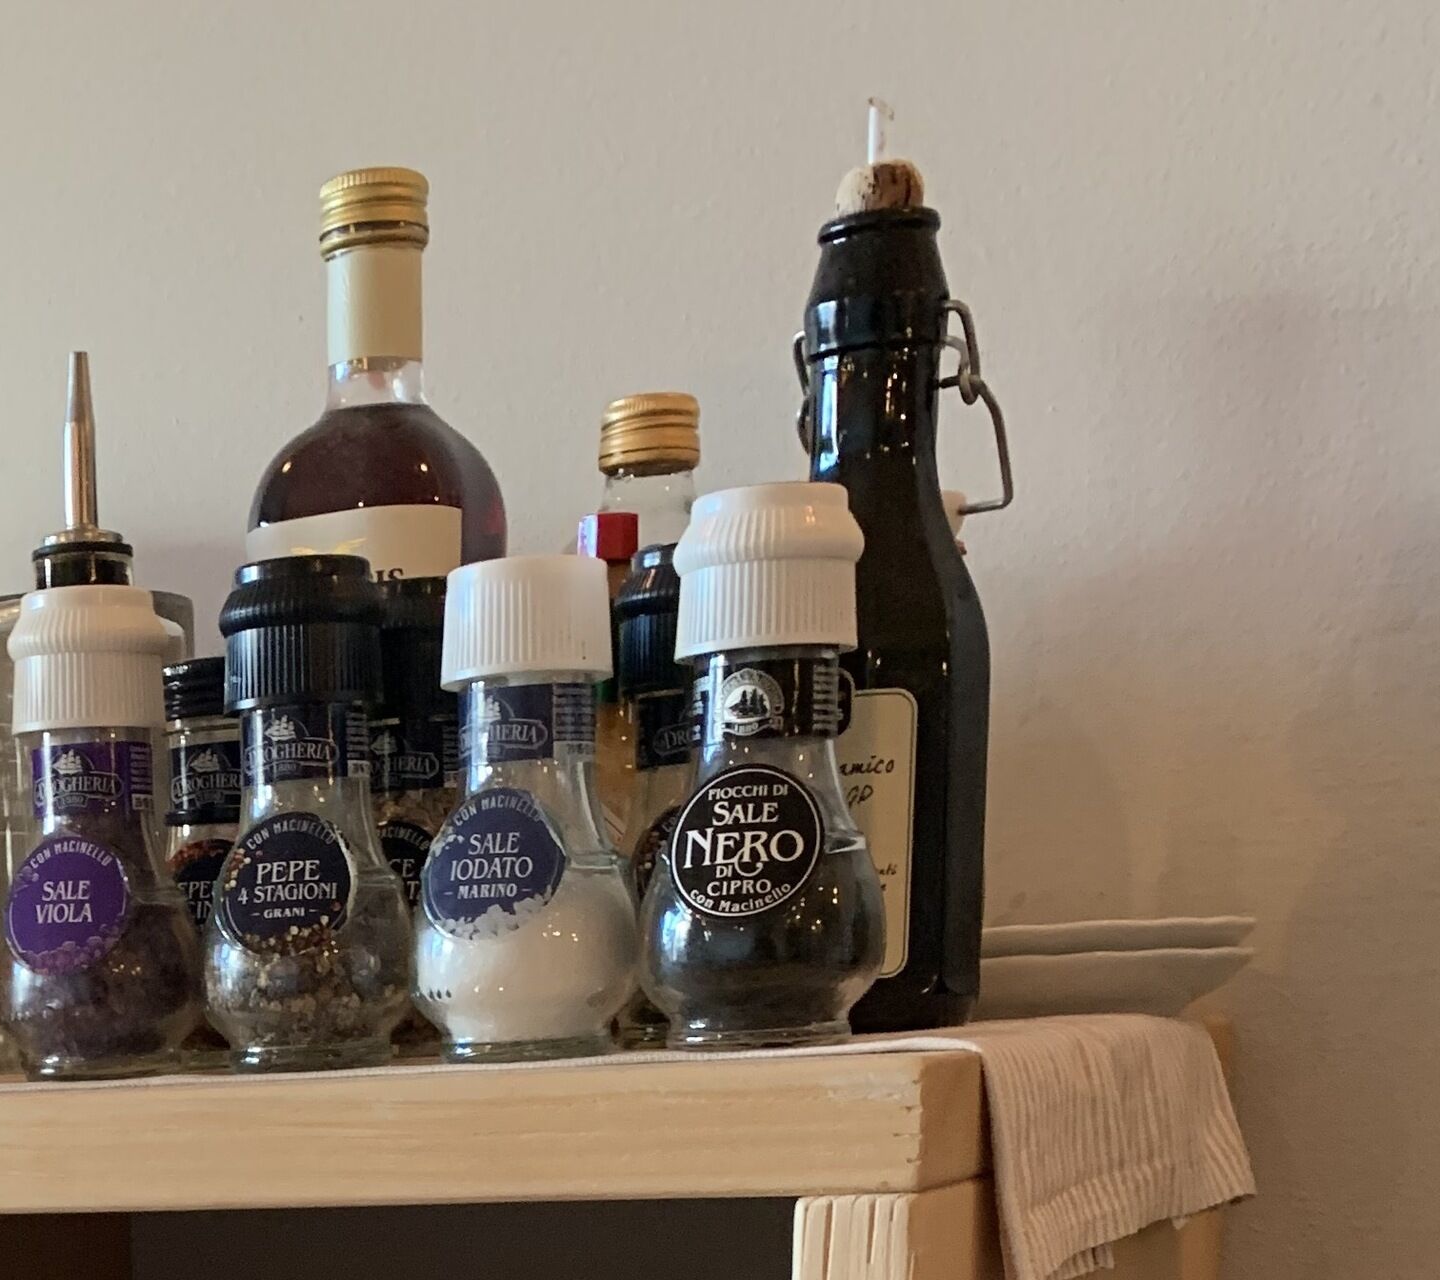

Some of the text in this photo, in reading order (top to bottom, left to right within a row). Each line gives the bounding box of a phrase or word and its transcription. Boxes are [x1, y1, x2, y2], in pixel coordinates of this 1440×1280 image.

[248, 742, 331, 770] DOGHERIA
[175, 772, 242, 798] DROGHERI
[708, 784, 789, 800] FIOCCHI DI
[453, 804, 478, 827] CON
[712, 801, 780, 826] SALE
[246, 828, 270, 850] CON
[468, 832, 521, 855] SALE
[29, 840, 114, 869] CON MACINELLO
[683, 827, 805, 877] NERO
[256, 860, 320, 884] PEPE
[450, 856, 534, 881] IODATO
[716, 865, 734, 878] DI
[42, 880, 91, 902] SALE
[238, 882, 338, 905] 4 STAGIONI
[457, 883, 518, 899] MARINO
[707, 879, 772, 897] CIPRO
[36, 903, 93, 924] VIOLA
[263, 907, 305, 919] GRANI
